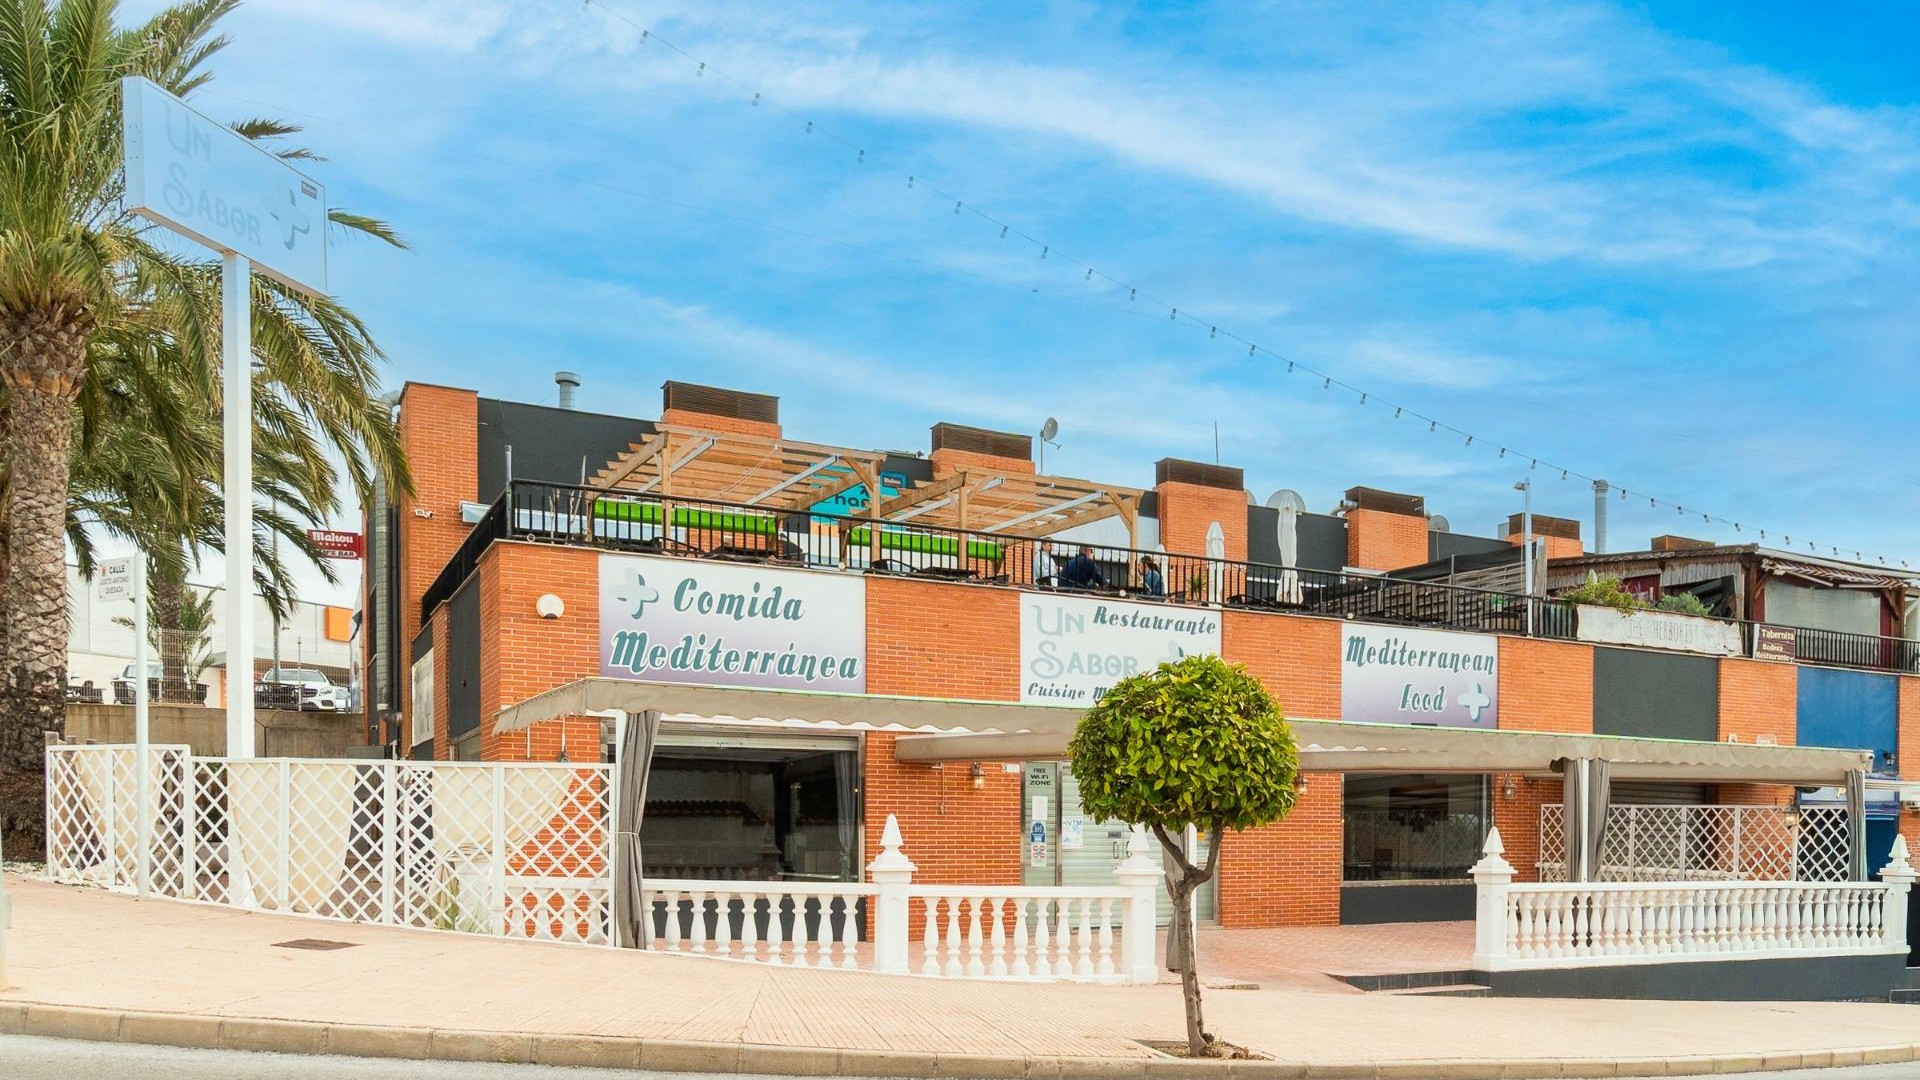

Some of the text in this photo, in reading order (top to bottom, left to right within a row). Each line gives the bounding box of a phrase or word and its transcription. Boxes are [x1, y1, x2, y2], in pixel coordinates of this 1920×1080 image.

[312, 531, 354, 544] Mahou
[109, 564, 126, 574] CALLE
[674, 577, 804, 622] Comida
[1093, 605, 1217, 636] Restaurante
[610, 629, 859, 682] Mediterránea
[1345, 635, 1495, 676] Mediterranean
[1027, 682, 1086, 700] Cuisine
[1400, 683, 1446, 712] Food
